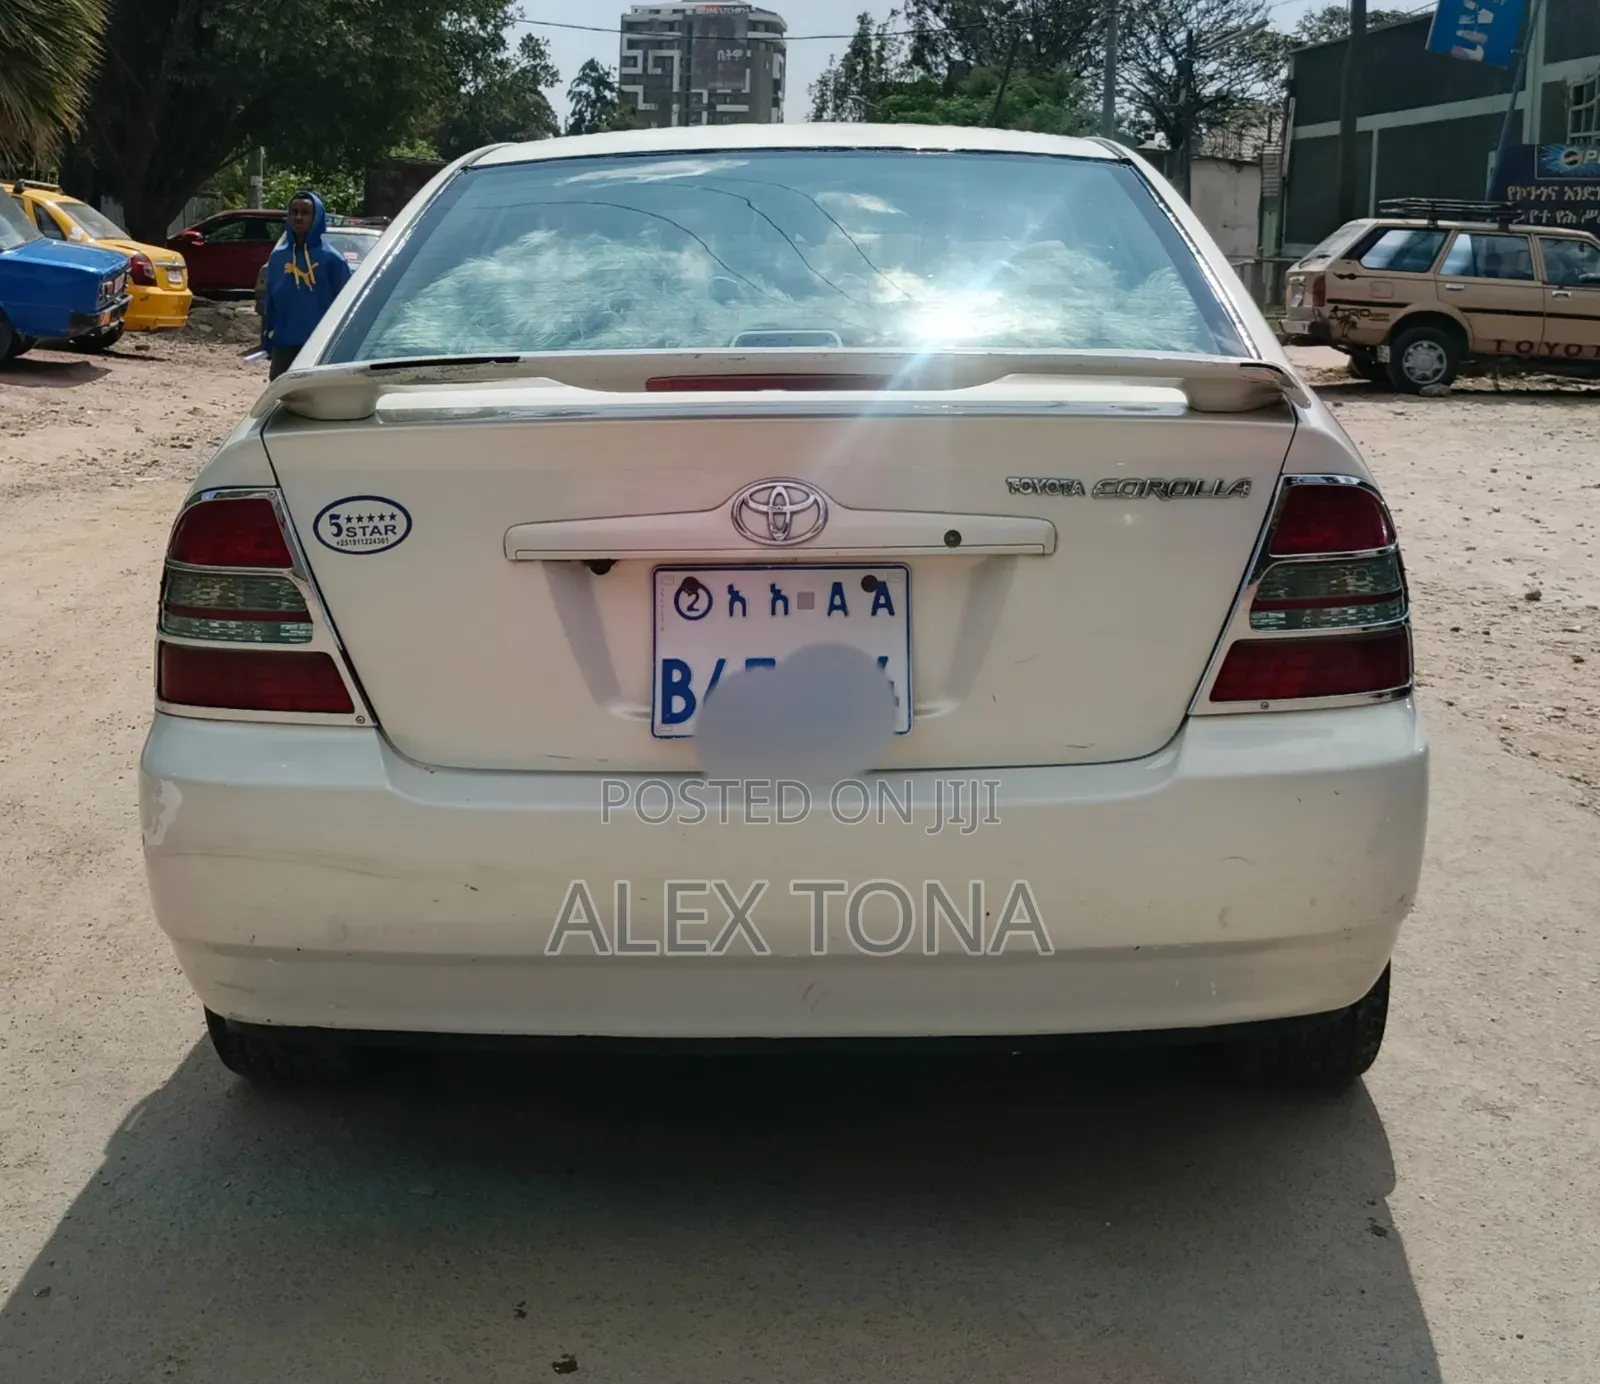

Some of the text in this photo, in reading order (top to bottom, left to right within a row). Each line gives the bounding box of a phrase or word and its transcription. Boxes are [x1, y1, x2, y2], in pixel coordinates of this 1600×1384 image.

[1005, 476, 1252, 501] TOYOTA COROLLA
[329, 513, 397, 538] 5 STAR
